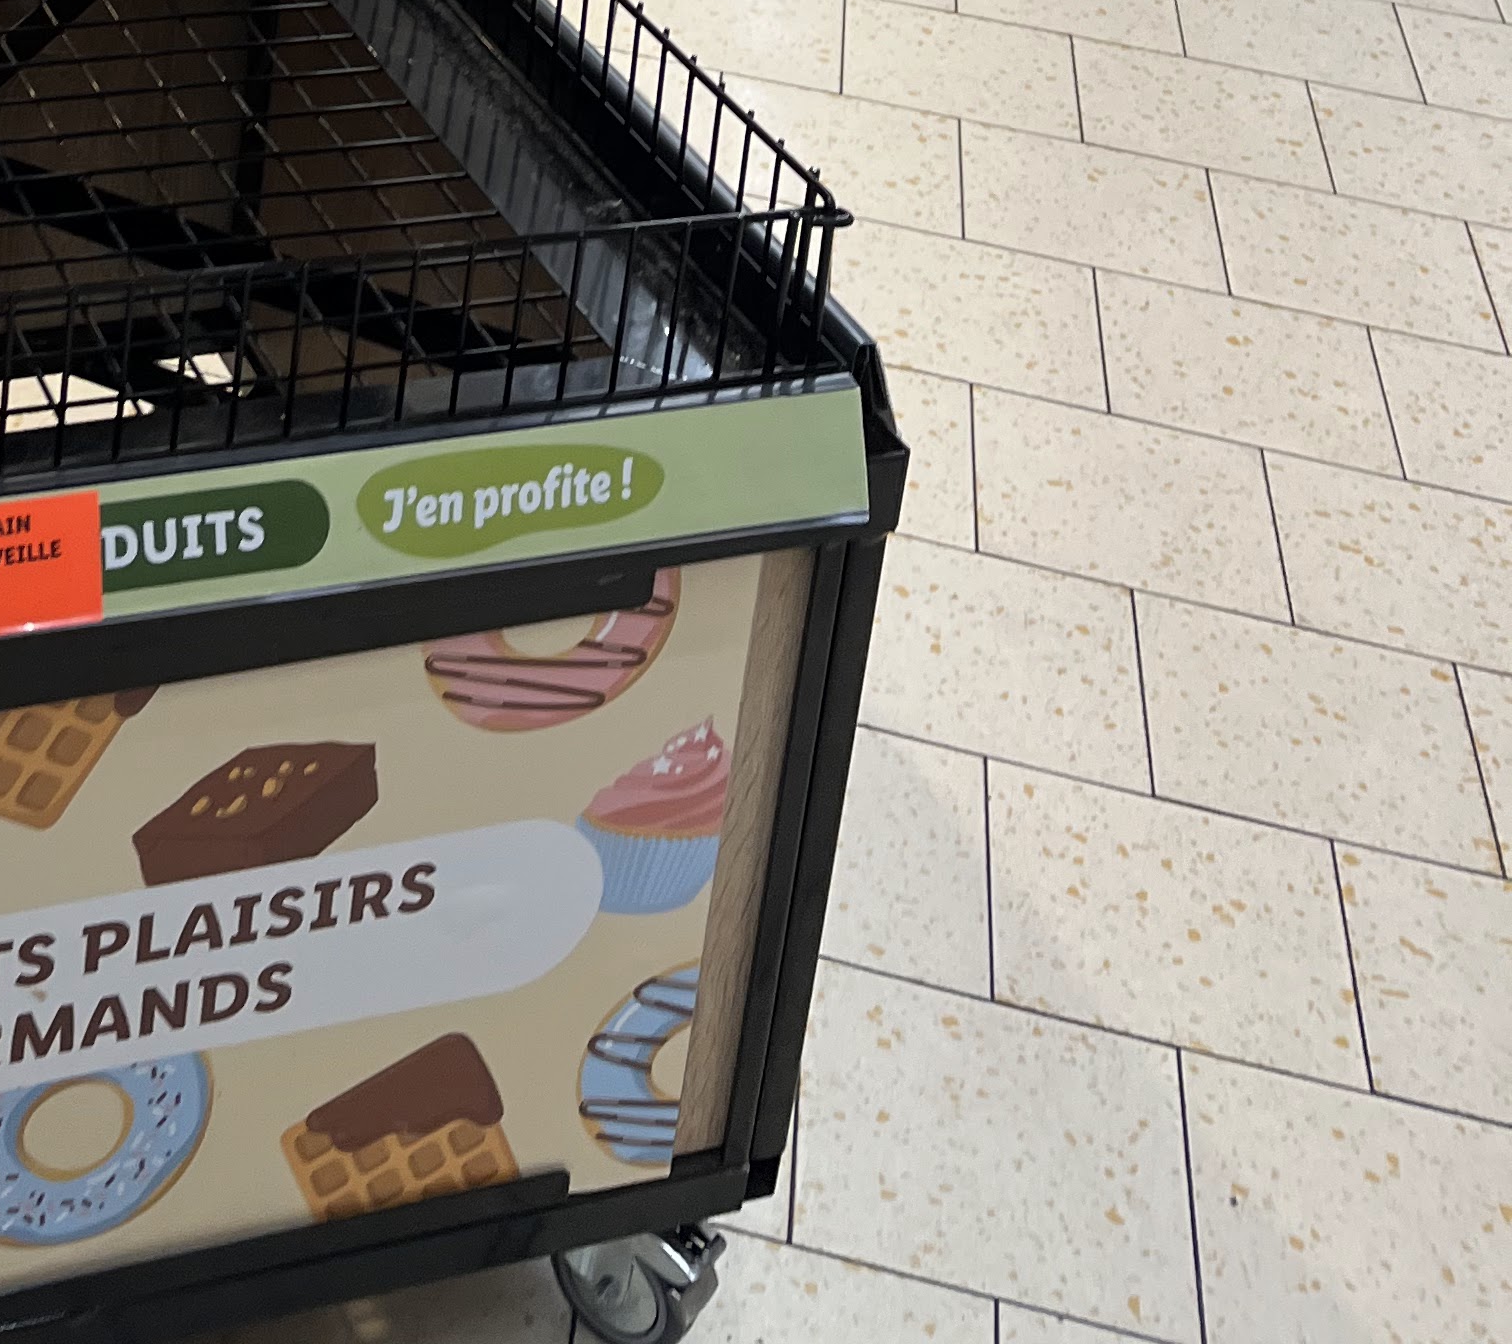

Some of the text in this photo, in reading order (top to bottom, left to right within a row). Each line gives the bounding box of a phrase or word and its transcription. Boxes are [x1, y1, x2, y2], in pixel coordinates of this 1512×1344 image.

[382, 457, 634, 534] J'en profite !
[101, 506, 266, 571] DUITS
[82, 861, 439, 974] PLAISIRS
